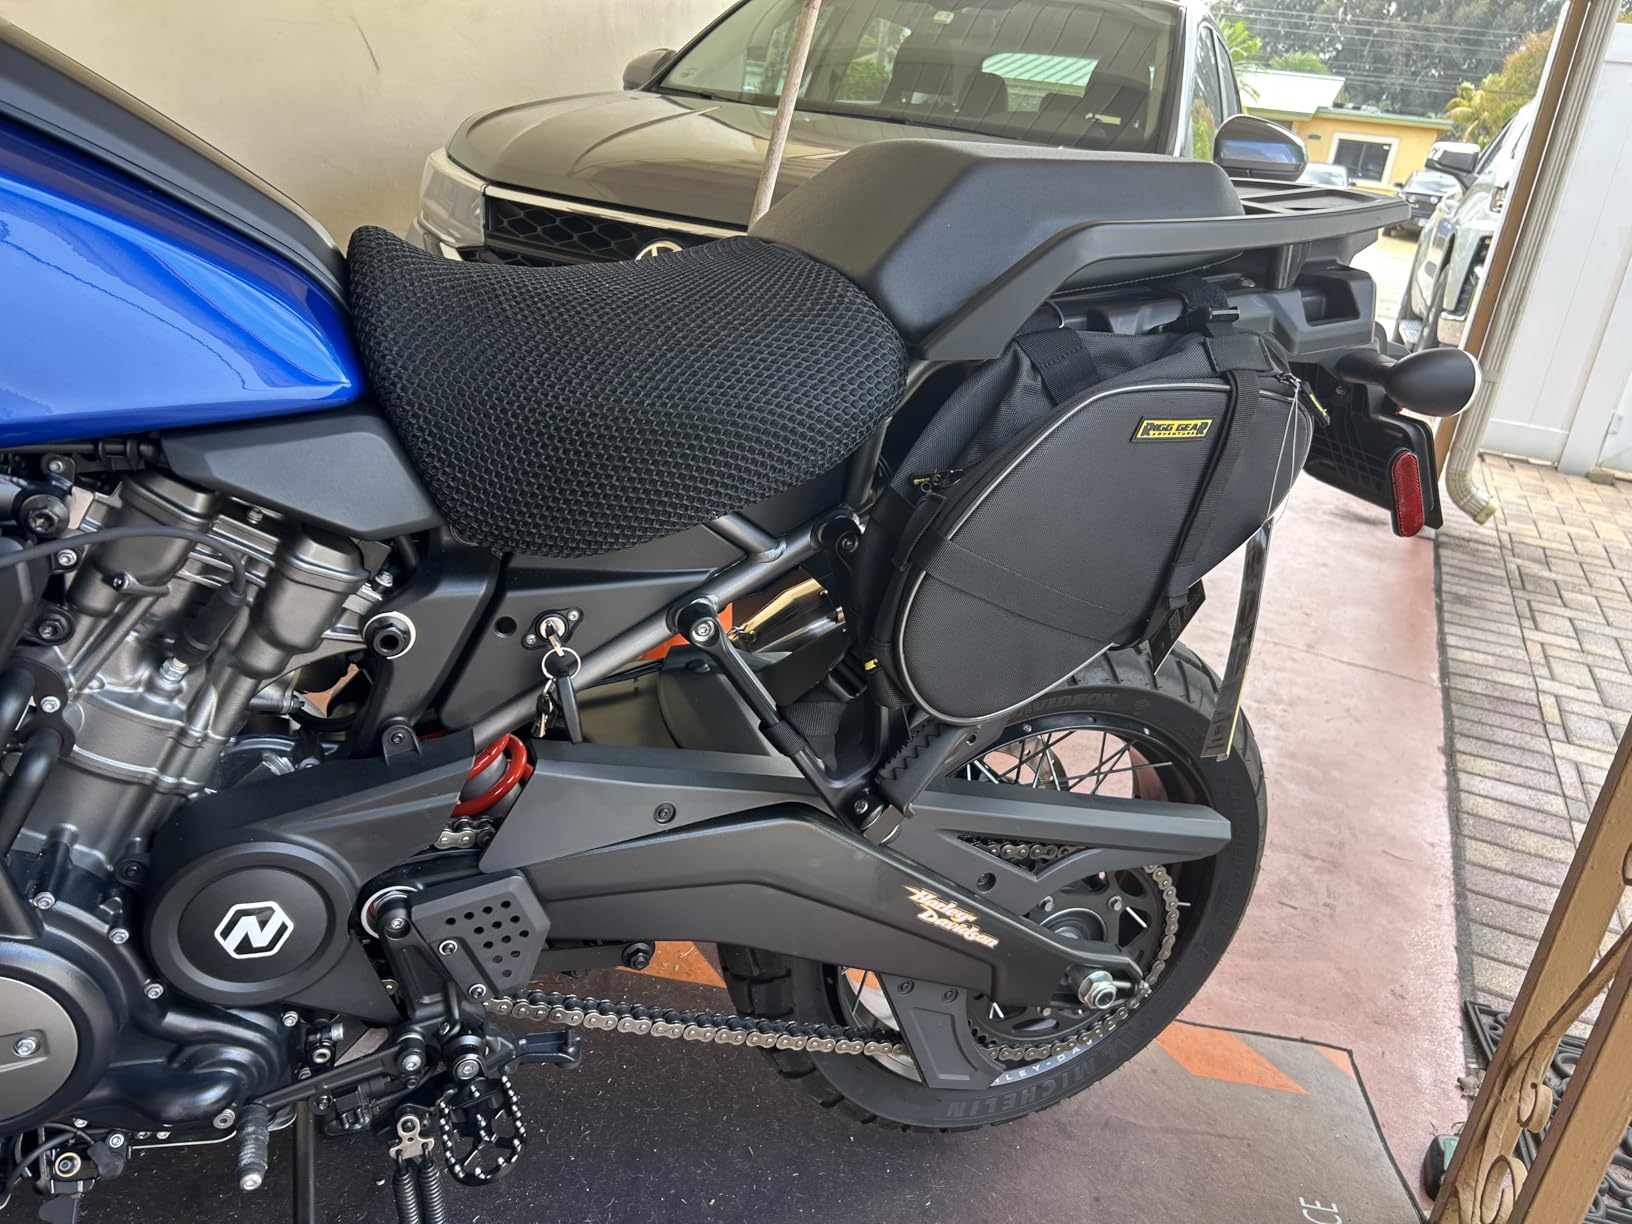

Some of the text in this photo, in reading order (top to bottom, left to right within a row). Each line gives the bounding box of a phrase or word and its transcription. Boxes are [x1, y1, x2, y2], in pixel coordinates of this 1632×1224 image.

[1140, 421, 1209, 436] RIGG GEAR
[945, 1058, 1096, 1119] MICHELIN
